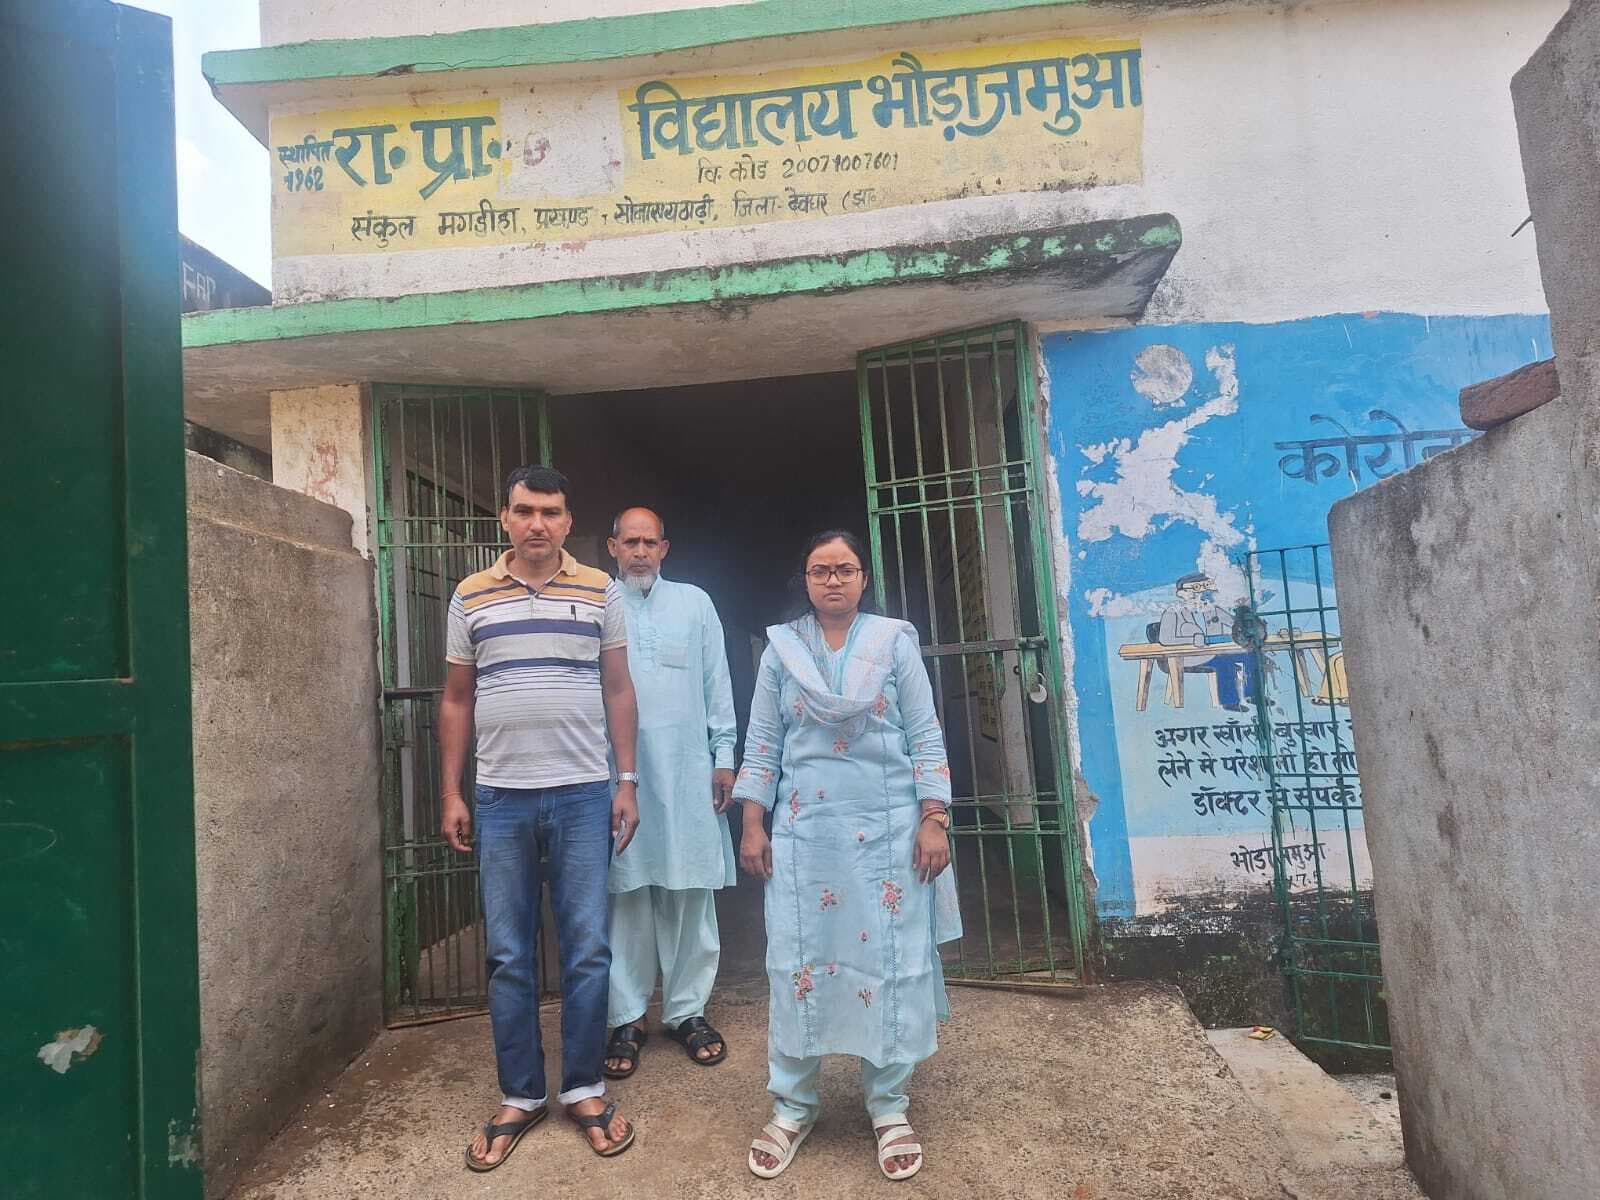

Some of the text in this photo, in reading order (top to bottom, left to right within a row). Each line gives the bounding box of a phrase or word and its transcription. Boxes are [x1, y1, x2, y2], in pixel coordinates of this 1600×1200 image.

[628, 80, 862, 160] विद्यालय
[729, 153, 768, 182] कोड
[352, 209, 416, 248] संकुल
[1155, 726, 1211, 748] अगर
[1157, 751, 1195, 788] लेने
[1192, 786, 1266, 816] डॉक्टर
